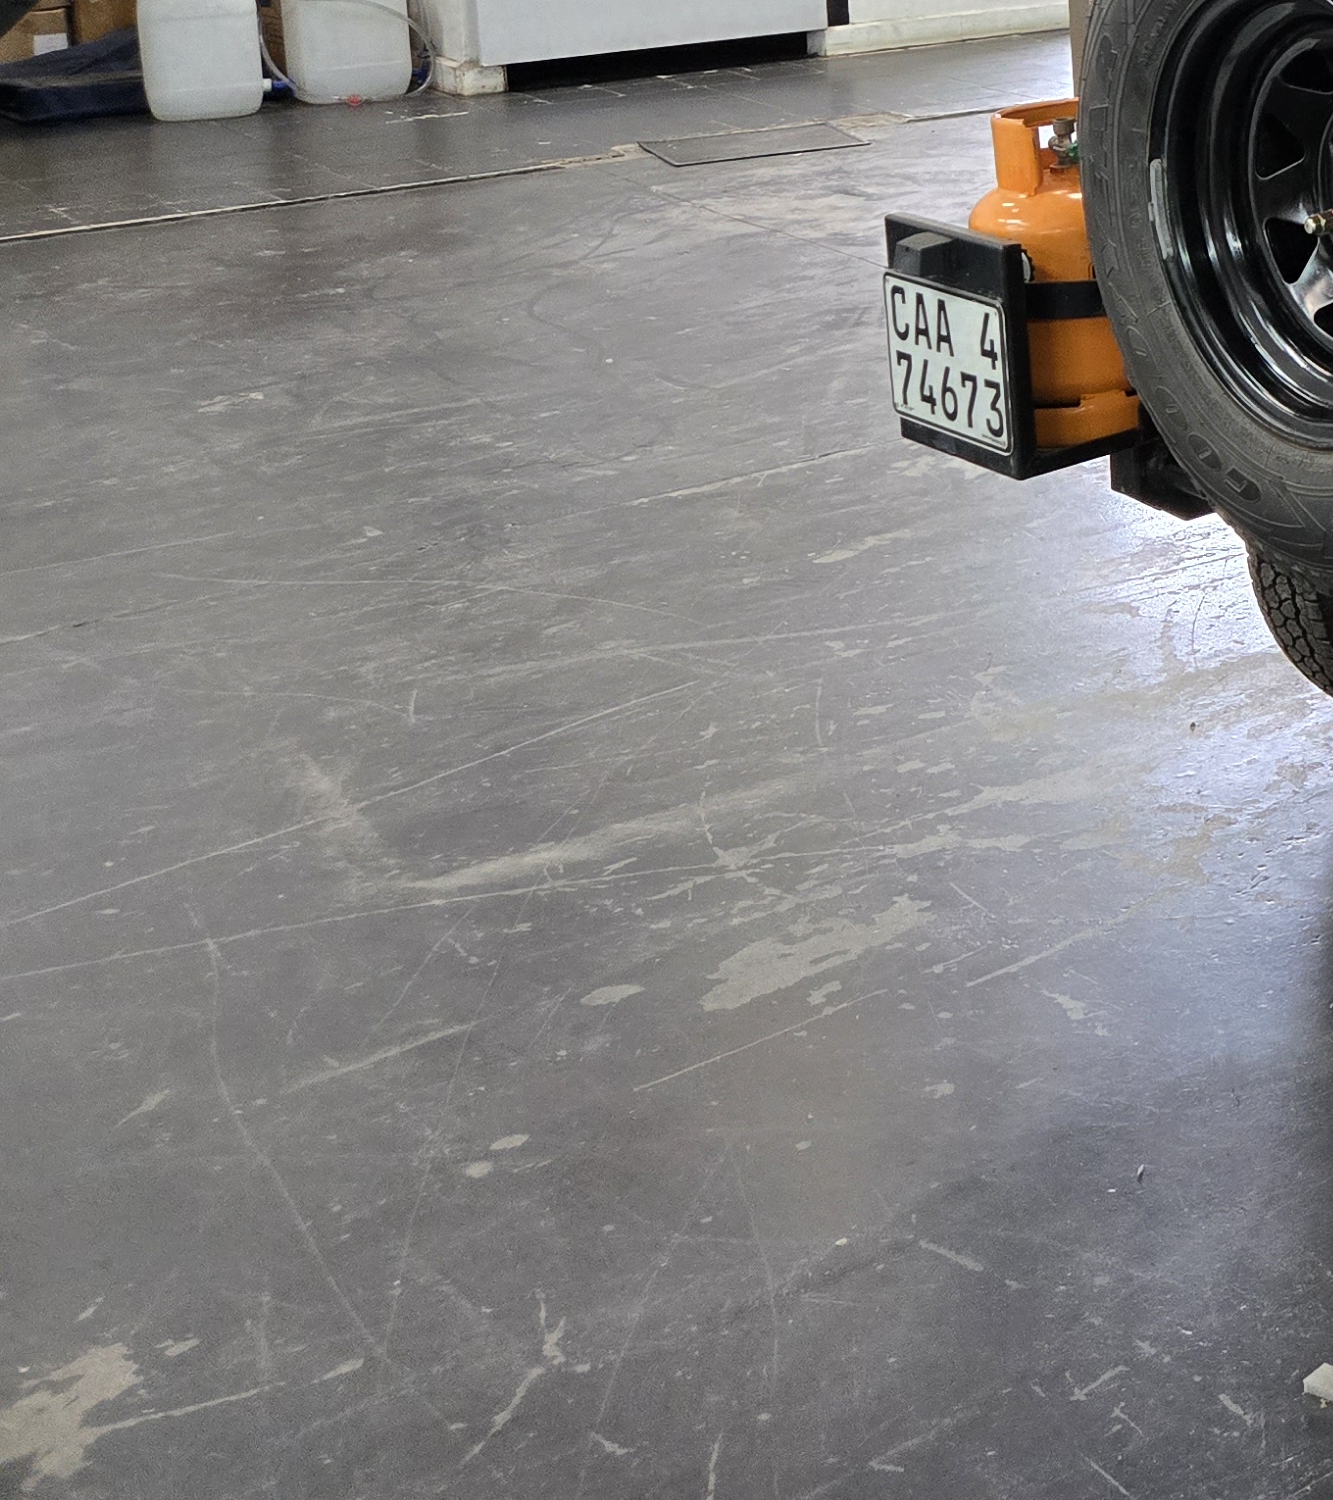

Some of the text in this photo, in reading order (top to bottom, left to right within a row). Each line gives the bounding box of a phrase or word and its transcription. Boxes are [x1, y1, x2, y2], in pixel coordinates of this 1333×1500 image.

[891, 285, 998, 370] CAA 4
[896, 350, 1004, 438] 74673
